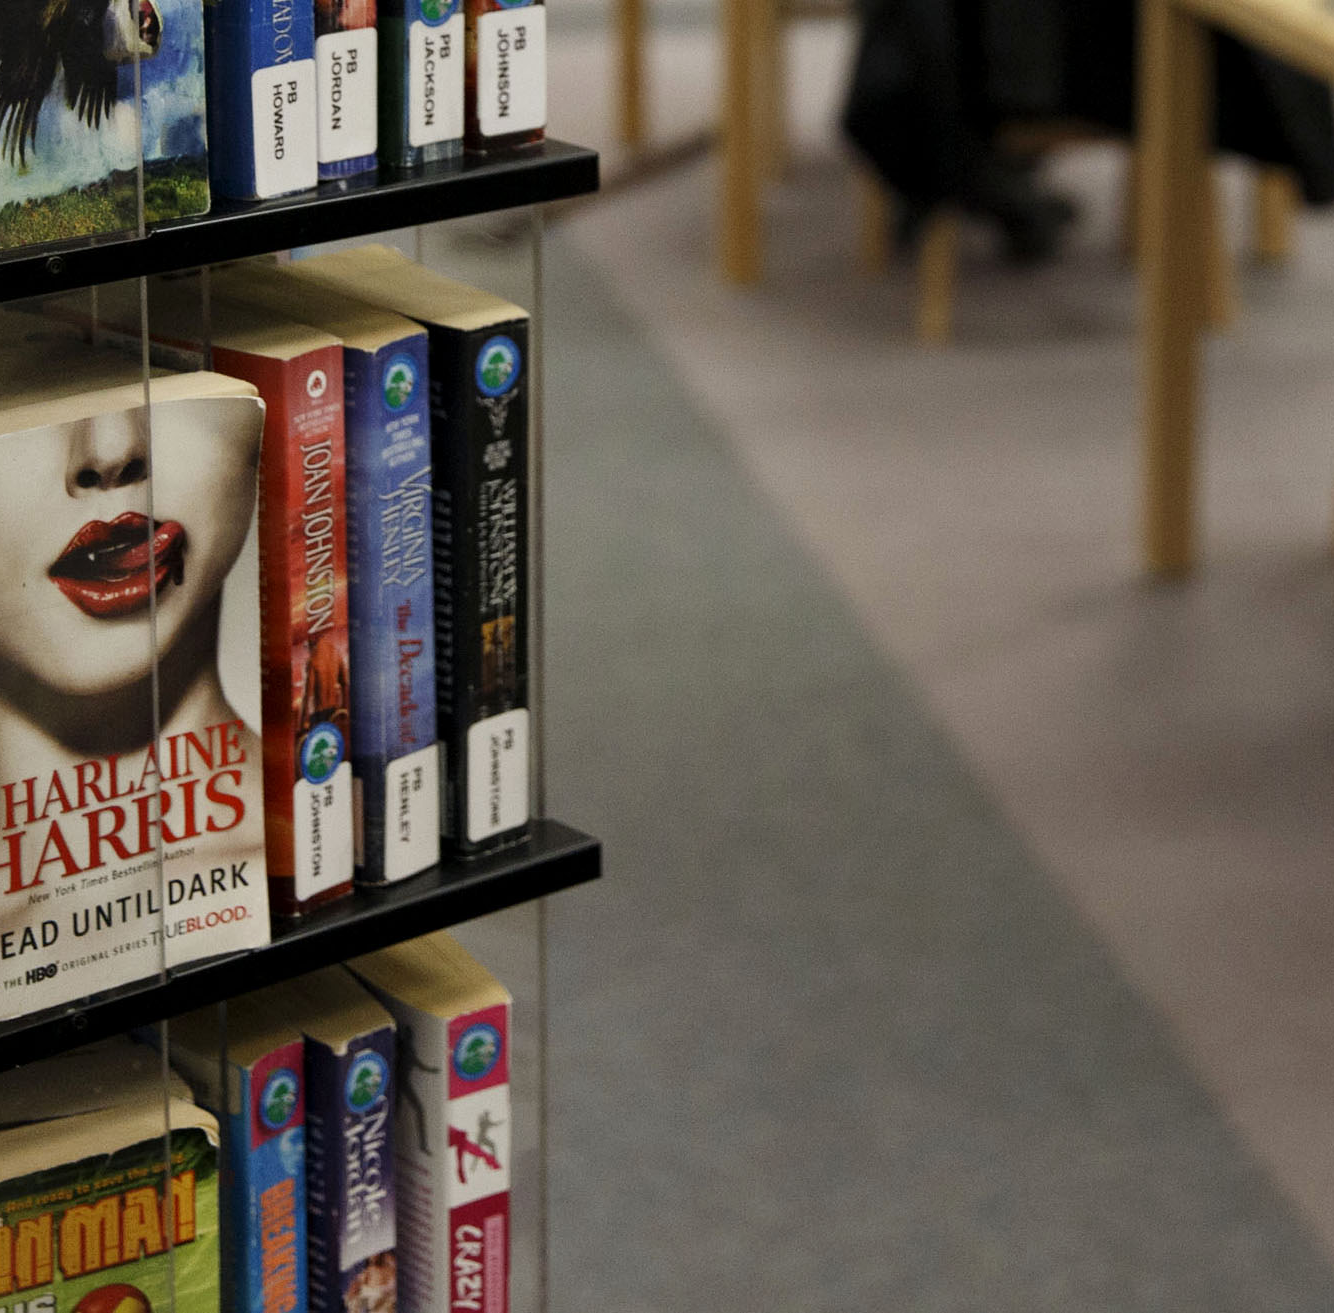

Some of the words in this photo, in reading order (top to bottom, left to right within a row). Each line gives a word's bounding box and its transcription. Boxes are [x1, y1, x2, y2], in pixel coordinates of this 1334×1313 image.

[347, 49, 357, 74] PB
[440, 34, 450, 58] PB
[497, 29, 509, 118] JOHNSON
[515, 26, 525, 50] PB
[288, 81, 297, 104] PB
[331, 52, 343, 130] JORDAN
[425, 36, 434, 127] JACKSON
[272, 84, 284, 160] HOWARD
[301, 439, 332, 506] JOAN
[301, 510, 335, 634] JOHNSTON
[28, 893, 50, 906] New
[81, 875, 109, 889] Times
[72, 889, 160, 937] UNTIL
[167, 861, 249, 906] DARK
[3, 976, 23, 989] THE
[61, 950, 110, 972] ORIGINAL
[113, 938, 148, 956] SERIES
[59, 1171, 195, 1281] MAN
[453, 1224, 483, 1310] CRAZY
